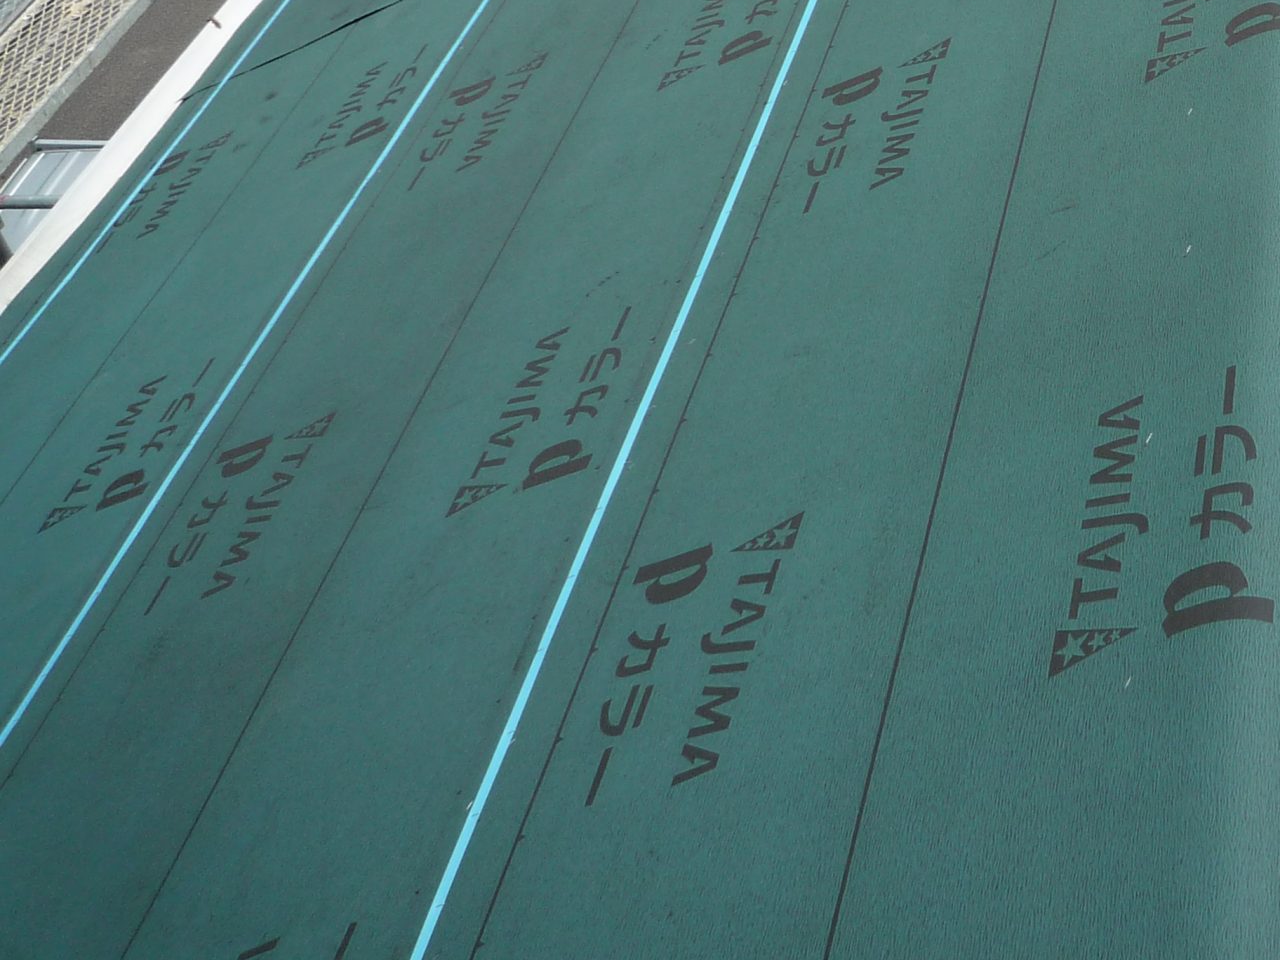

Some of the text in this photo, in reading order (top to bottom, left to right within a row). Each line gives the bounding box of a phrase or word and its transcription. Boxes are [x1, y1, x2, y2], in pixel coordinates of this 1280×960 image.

[455, 74, 532, 173] TAJIMA
[869, 64, 937, 190] TAJIMA
[63, 375, 167, 502] TAJIMA
[471, 327, 570, 479] TAJIMA
[201, 443, 313, 600] TAJIMA
[1069, 395, 1149, 620] TAJIMA
[671, 558, 781, 787] TAJIMA
